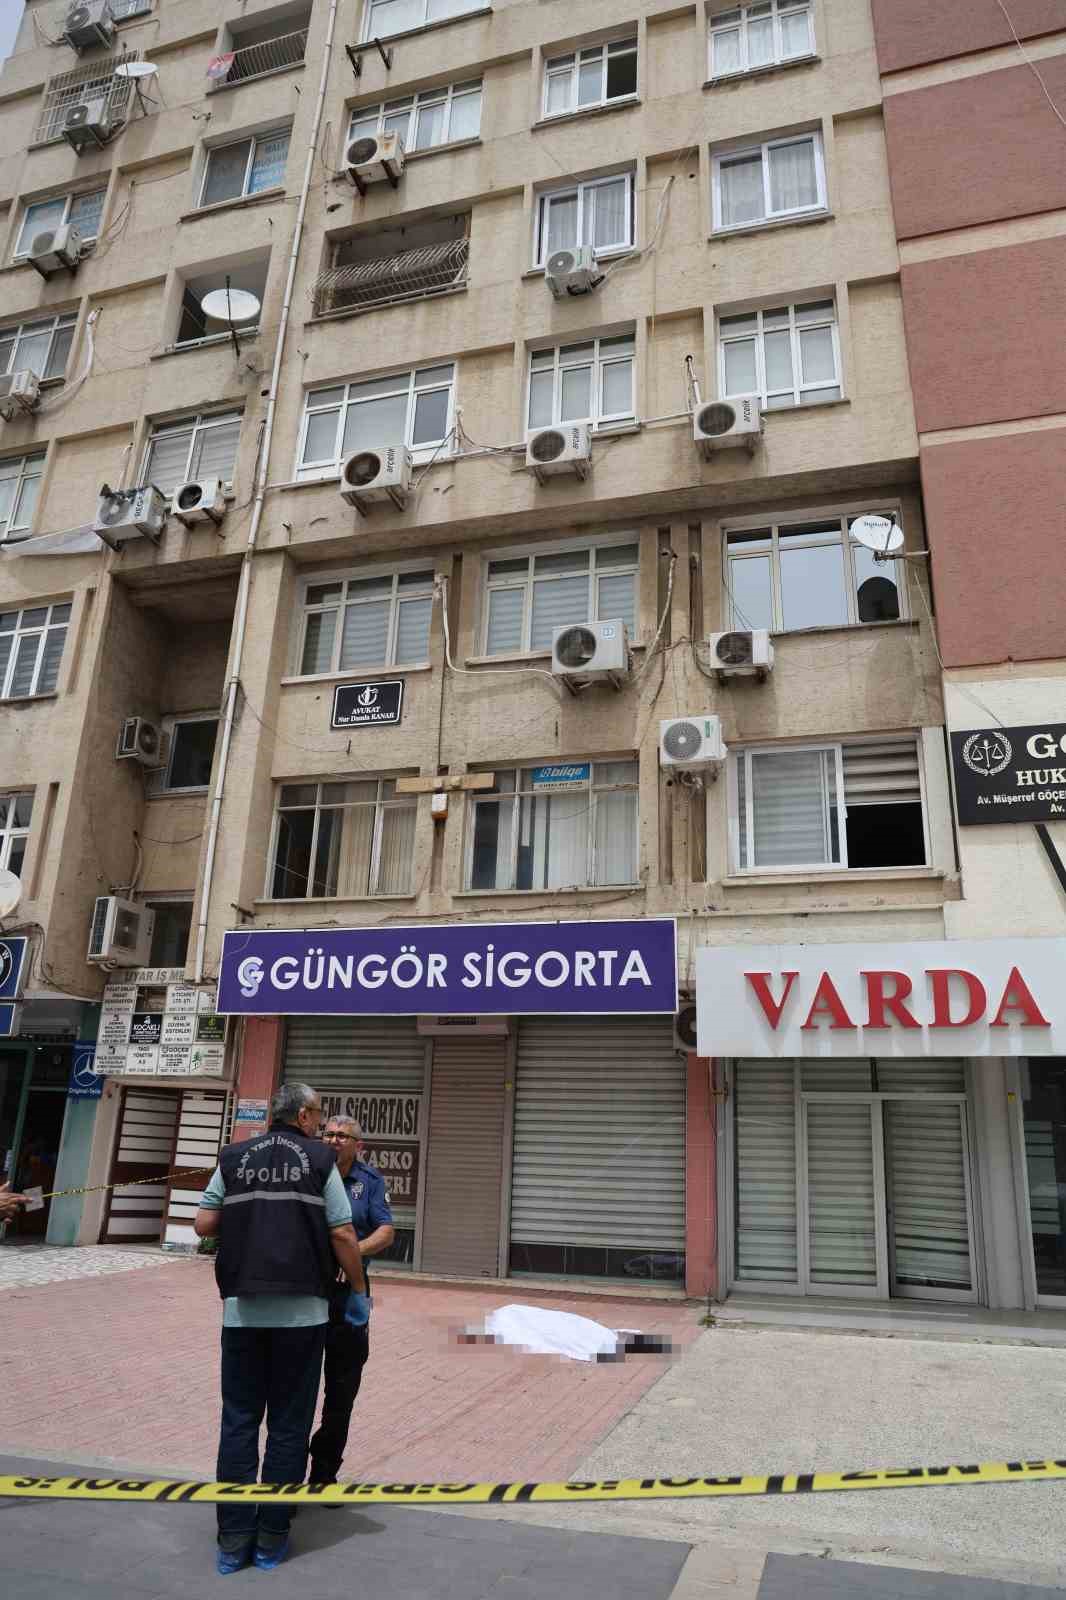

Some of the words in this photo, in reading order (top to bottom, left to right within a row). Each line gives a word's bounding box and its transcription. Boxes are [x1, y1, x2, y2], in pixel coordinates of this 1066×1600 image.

[351, 706, 381, 715] AVUKAT
[1026, 733, 1066, 759] G
[1015, 767, 1066, 786] HUK
[976, 795, 992, 805] Av.
[993, 792, 1035, 805] Müşerref
[1037, 788, 1066, 802] GÖÇE
[1050, 803, 1065, 813] Av.
[270, 945, 448, 990] GÜNGÖR
[461, 943, 652, 988] SİGORTA
[744, 966, 1052, 1031] VARDA
[357, 1150, 413, 1169] KASKO
[245, 1162, 302, 1185] POLİS
